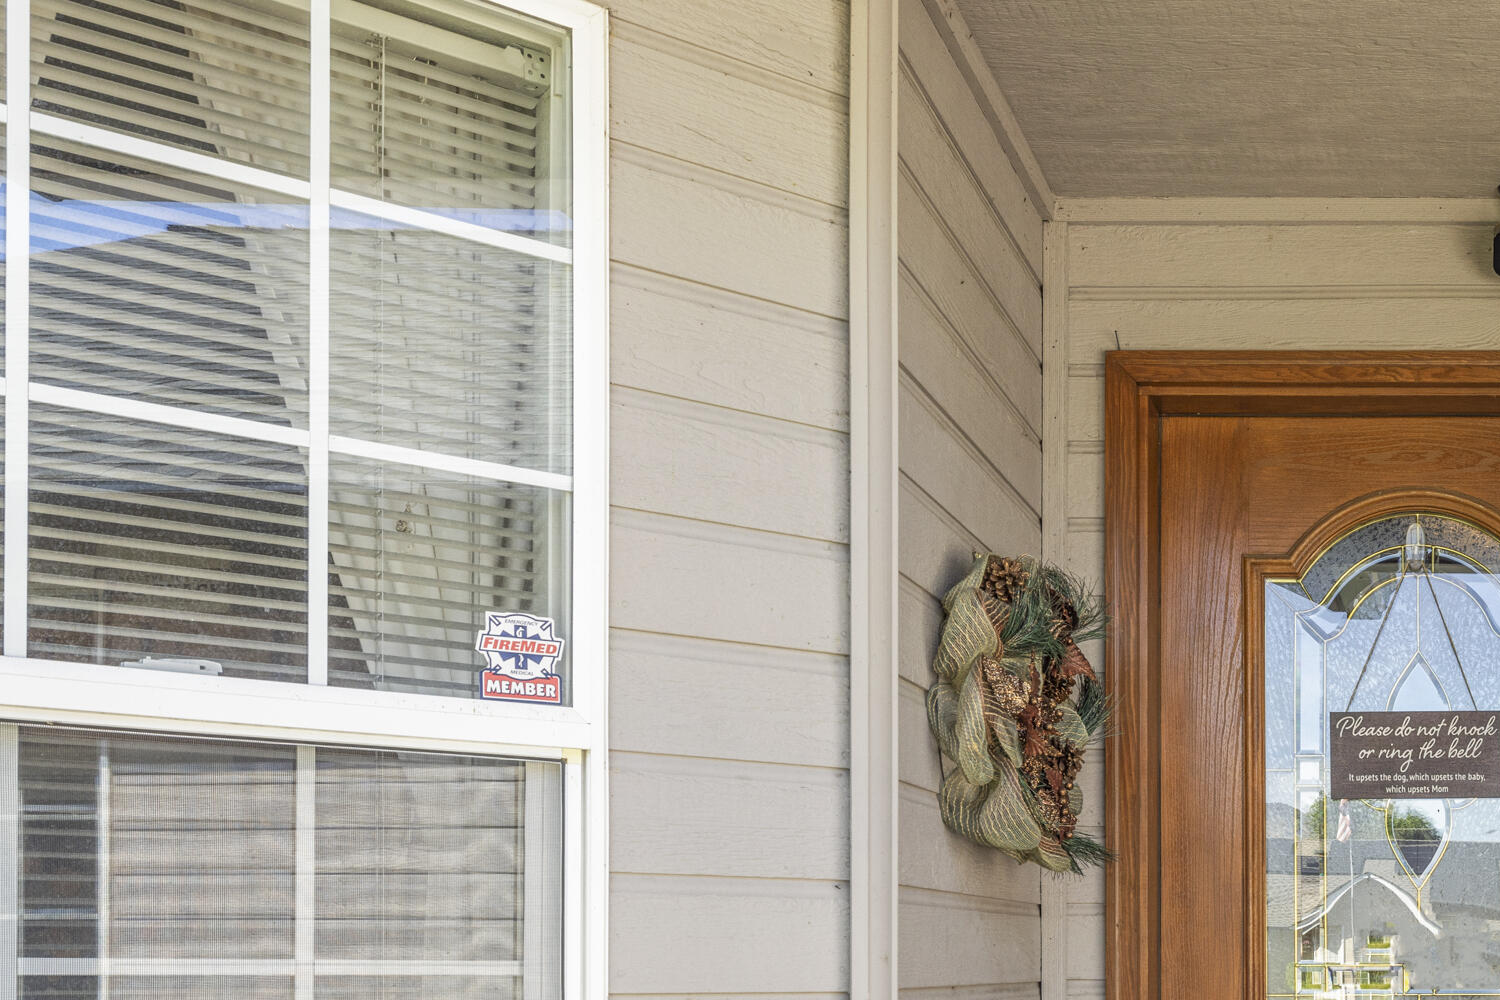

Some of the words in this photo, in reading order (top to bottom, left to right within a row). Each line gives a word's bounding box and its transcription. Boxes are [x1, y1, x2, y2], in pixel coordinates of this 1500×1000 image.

[486, 679, 556, 697] MEMBER
[1336, 715, 1394, 738] Please
[1394, 715, 1415, 738] do
[1416, 718, 1447, 737] not
[1447, 715, 1498, 736] knock
[1358, 747, 1376, 759] or
[1378, 743, 1414, 772] ring
[1418, 738, 1446, 759] the
[1447, 737, 1482, 759] bell
[1349, 773, 1355, 782] It
[1356, 774, 1379, 783] upsets
[1380, 773, 1392, 782] the
[1393, 773, 1409, 783] dog,
[1409, 773, 1430, 782] which
[1430, 773, 1454, 783] upsets
[1454, 773, 1467, 781] the
[1468, 772, 1486, 783] baby,
[1386, 784, 1406, 793] which
[1407, 785, 1431, 794] upsets
[1432, 785, 1449, 793] Mom
